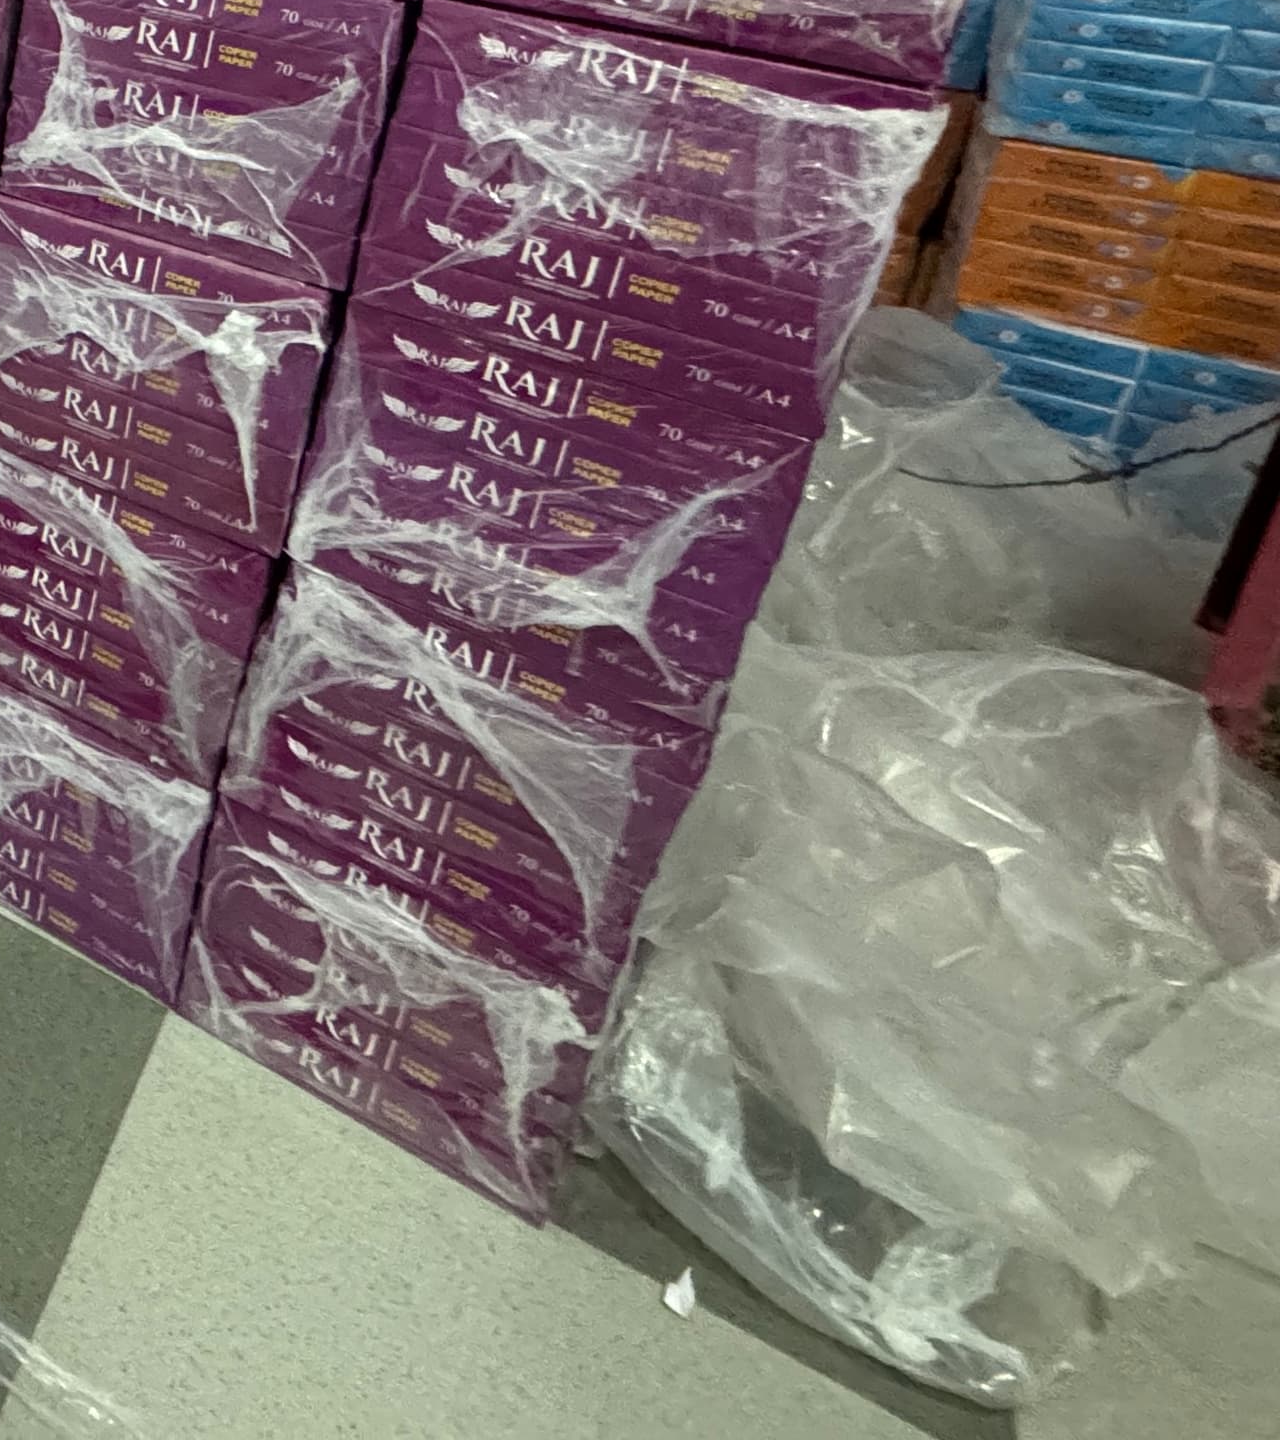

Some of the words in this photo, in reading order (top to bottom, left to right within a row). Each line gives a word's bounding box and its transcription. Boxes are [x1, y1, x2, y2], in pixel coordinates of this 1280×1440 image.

[224, 4, 259, 16] PAPER
[280, 10, 299, 24] 70
[336, 22, 360, 36] A4
[788, 14, 814, 31] 70
[136, 22, 196, 57] RAJ
[219, 45, 257, 59] COPIER
[218, 55, 253, 68] PAPER
[275, 62, 293, 76] 70
[578, 49, 665, 94] RAJ
[310, 192, 335, 207] A4
[89, 242, 145, 282] RAJ
[520, 241, 600, 288] RAJ
[629, 274, 680, 293] COPIER
[629, 286, 674, 304] PAPER
[505, 302, 585, 351] RAJ
[702, 300, 729, 318] 70
[779, 324, 815, 341] A4
[611, 350, 658, 368] PAPER
[613, 338, 664, 358] COPIER
[482, 358, 560, 404] RAJ
[685, 365, 711, 382] 70
[760, 389, 791, 408] A4
[65, 389, 116, 430] RAJ
[470, 415, 546, 464] RAJ
[659, 424, 683, 441] 70
[61, 438, 114, 480] RAJ
[448, 467, 525, 516] RAJ
[43, 524, 94, 566] RAJ
[169, 535, 185, 549] 70
[33, 566, 85, 609] RAJ
[682, 566, 716, 584] A4
[23, 607, 74, 650] RAJ
[664, 623, 698, 641] A4
[425, 626, 494, 676] RAJ
[384, 725, 451, 777] RAJ
[366, 769, 433, 821] RAJ
[359, 821, 425, 872] RAJ
[318, 1008, 379, 1057] RAJ
[300, 1049, 360, 1099] RAJ
